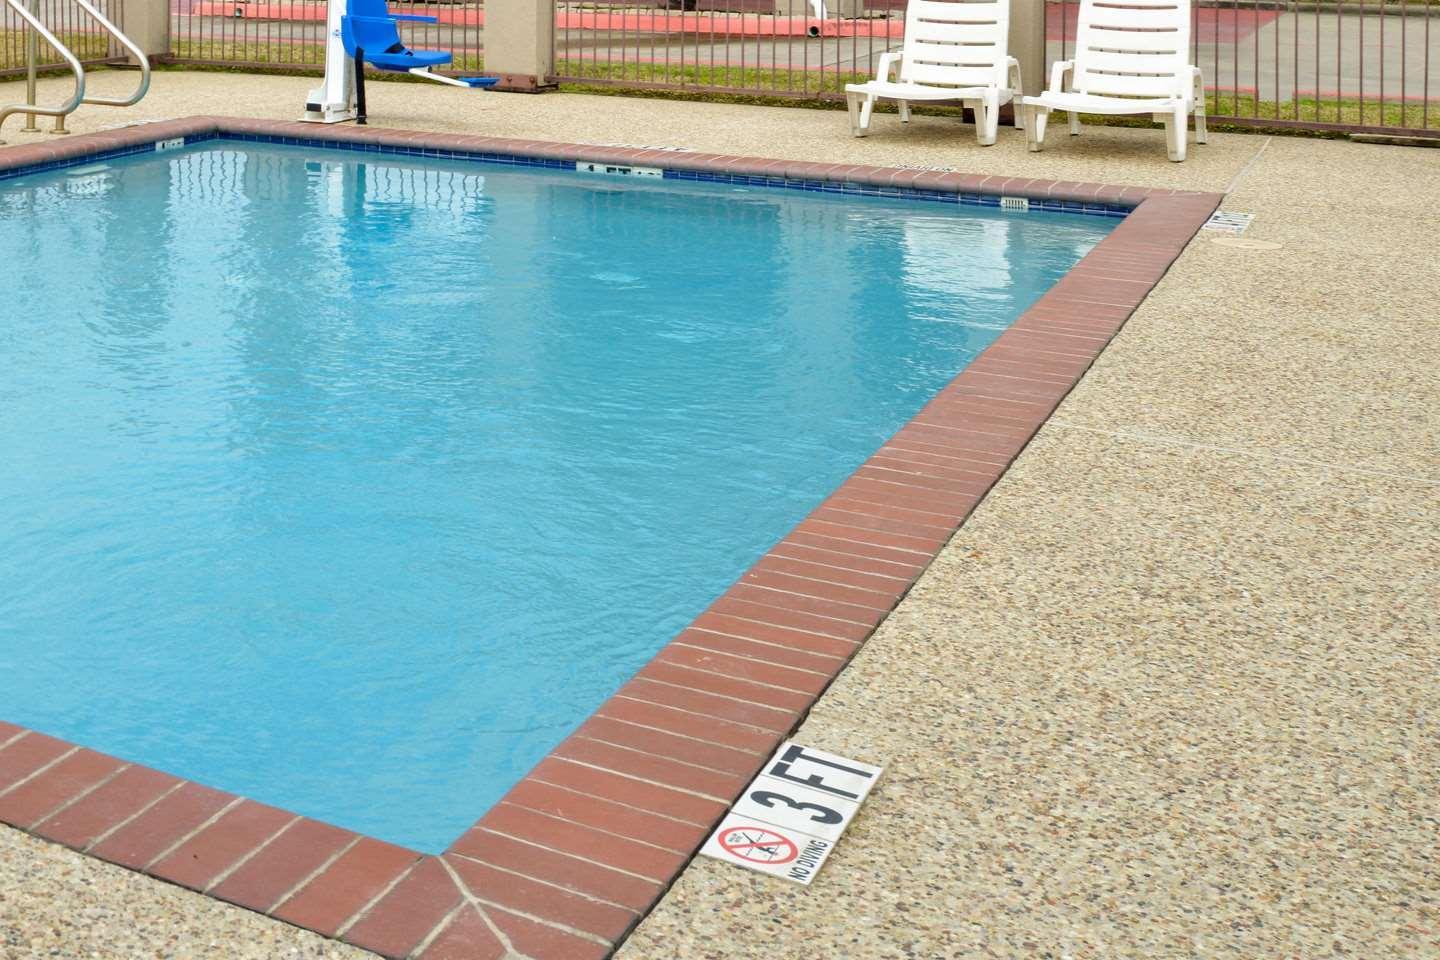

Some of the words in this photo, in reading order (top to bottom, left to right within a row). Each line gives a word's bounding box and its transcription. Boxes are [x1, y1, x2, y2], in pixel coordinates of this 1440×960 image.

[769, 744, 873, 800] FT
[750, 790, 843, 825] 3
[796, 839, 829, 868] DIVING
[787, 866, 811, 881] NO
